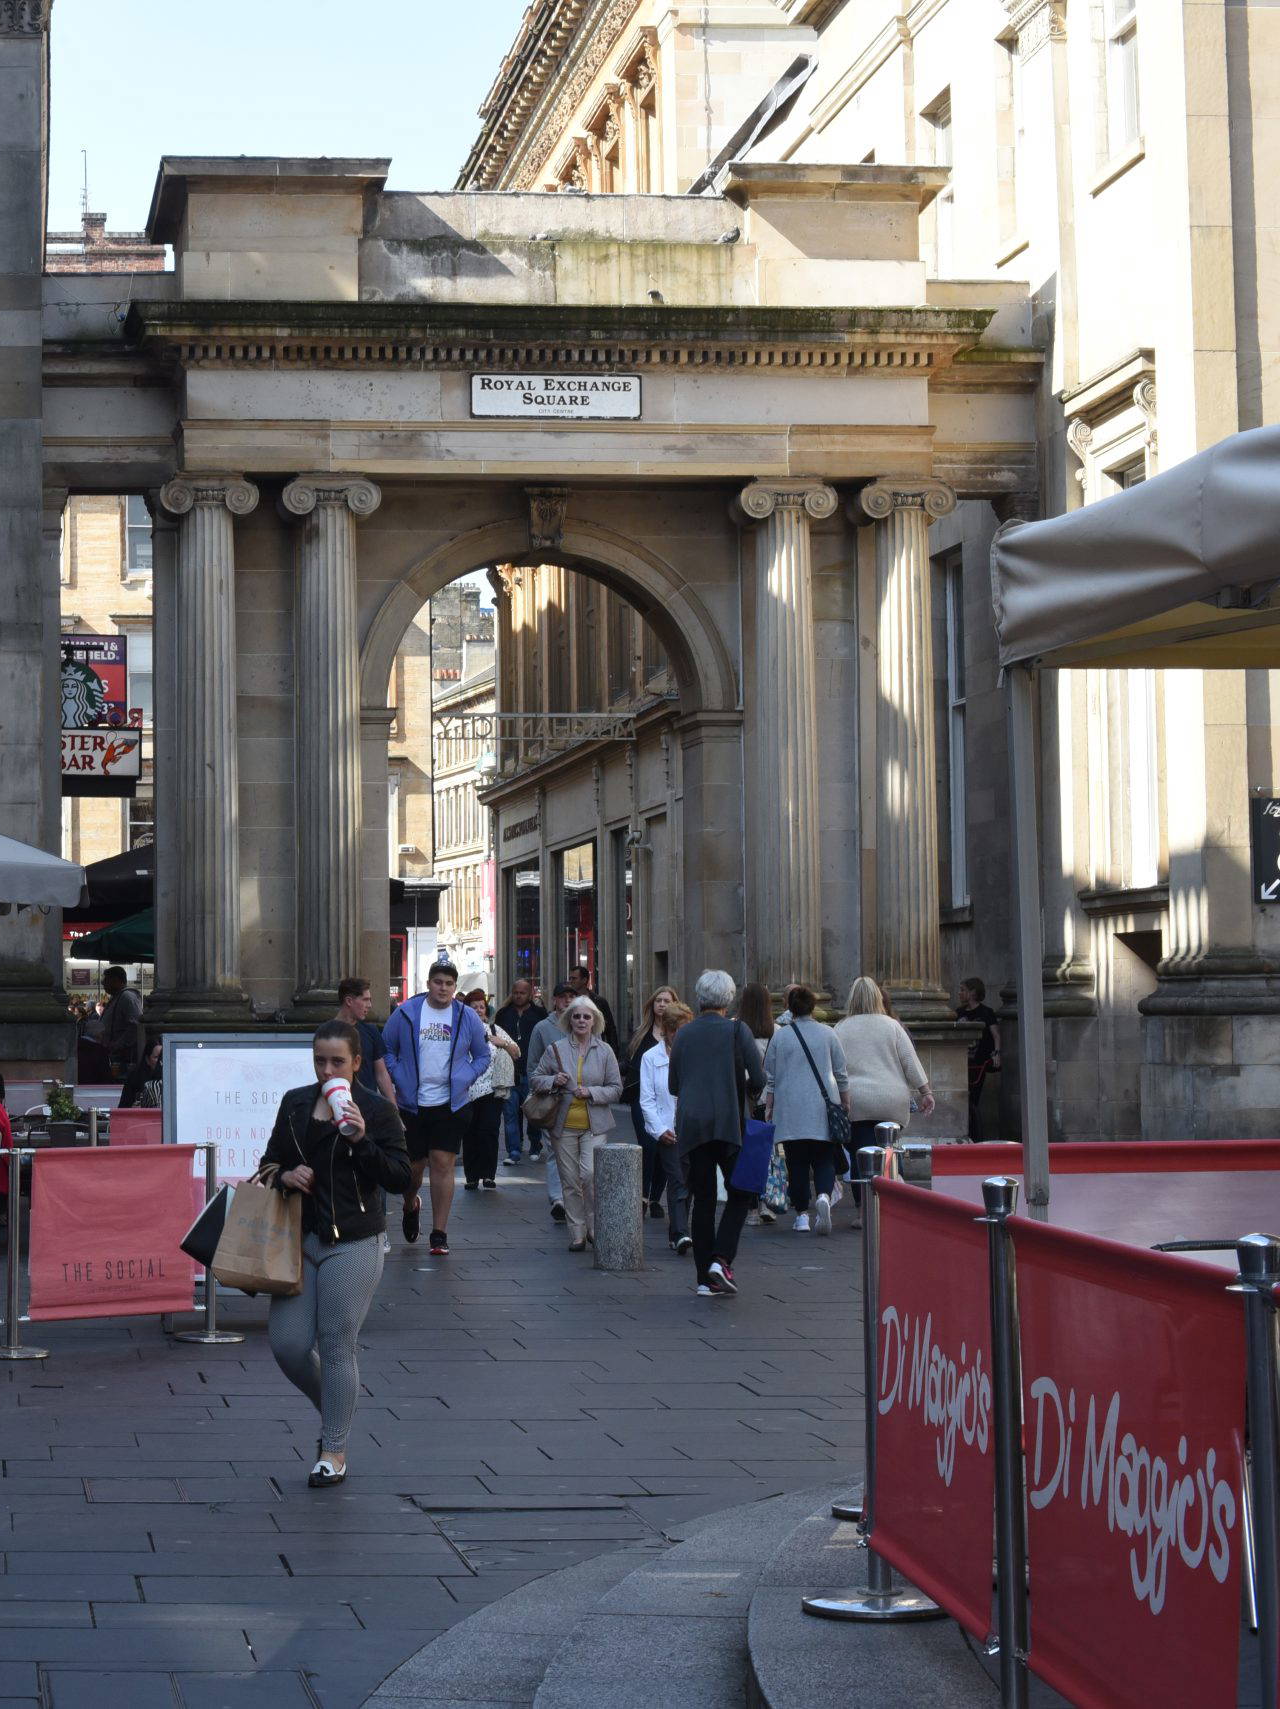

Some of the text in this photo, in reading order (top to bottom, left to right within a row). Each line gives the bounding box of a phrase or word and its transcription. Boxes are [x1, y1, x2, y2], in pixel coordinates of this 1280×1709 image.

[480, 377, 632, 392] ROYAL EXCHANGE
[522, 392, 590, 406] SQUARE
[215, 1091, 240, 1105] THE
[207, 1127, 241, 1140] BOOK
[62, 1258, 166, 1282] THE SOCIAL
[878, 1306, 991, 1487] Di Maggio's
[1030, 1376, 1236, 1615] Di Maggio's
